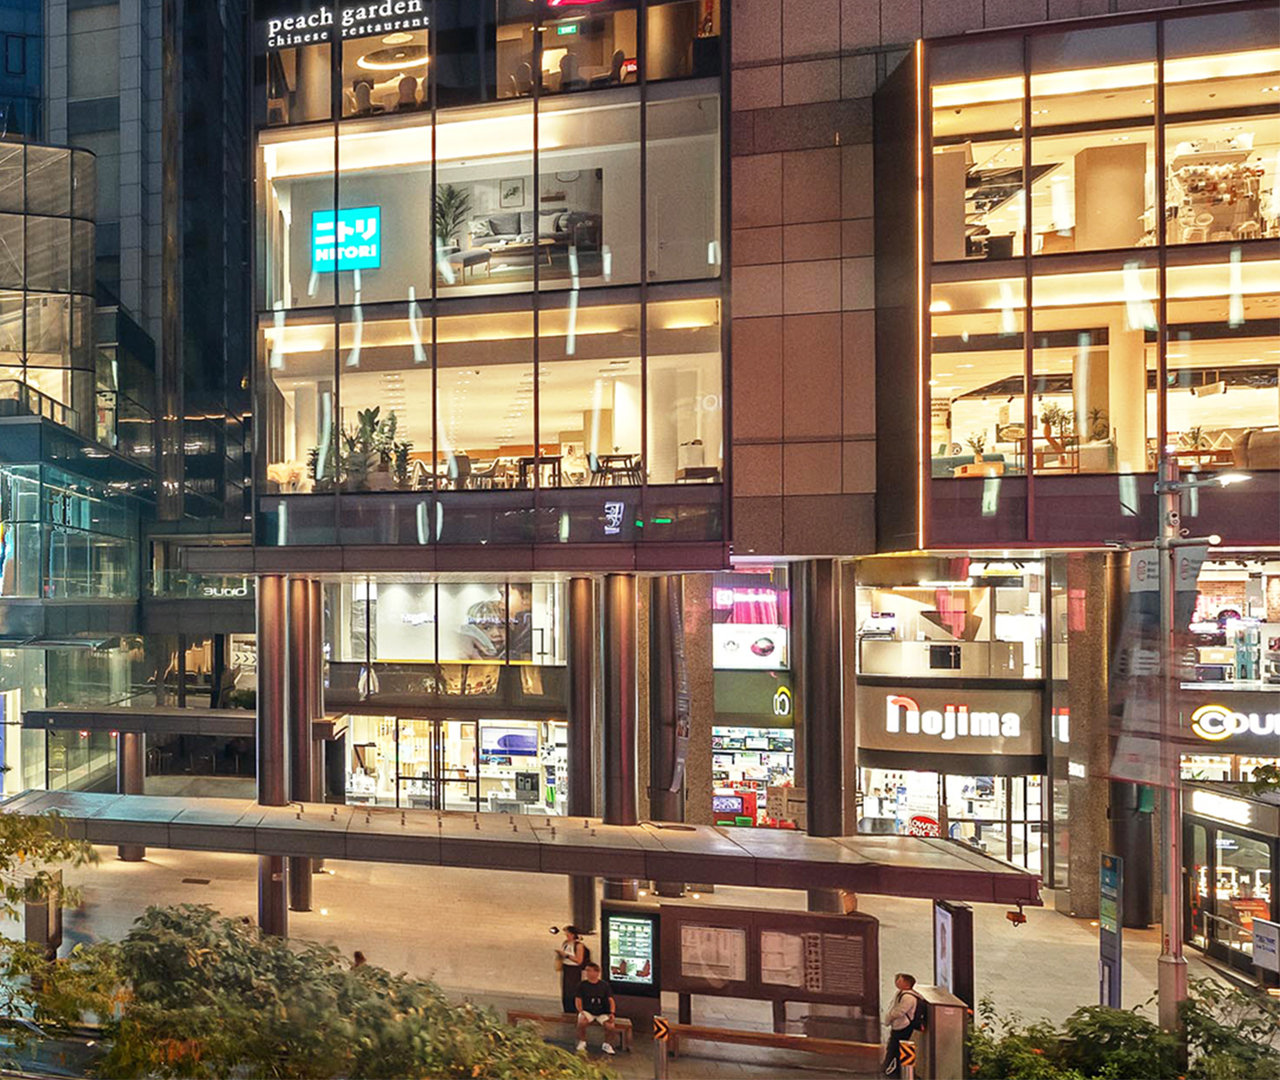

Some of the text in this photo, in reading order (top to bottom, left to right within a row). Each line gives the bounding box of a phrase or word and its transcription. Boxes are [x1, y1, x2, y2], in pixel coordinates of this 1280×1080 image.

[268, 6, 334, 37] peach
[268, 16, 430, 47] chinese restaurant
[315, 218, 377, 244] ニトリ
[315, 244, 377, 261] NITORI
[1195, 708, 1280, 738] COU
